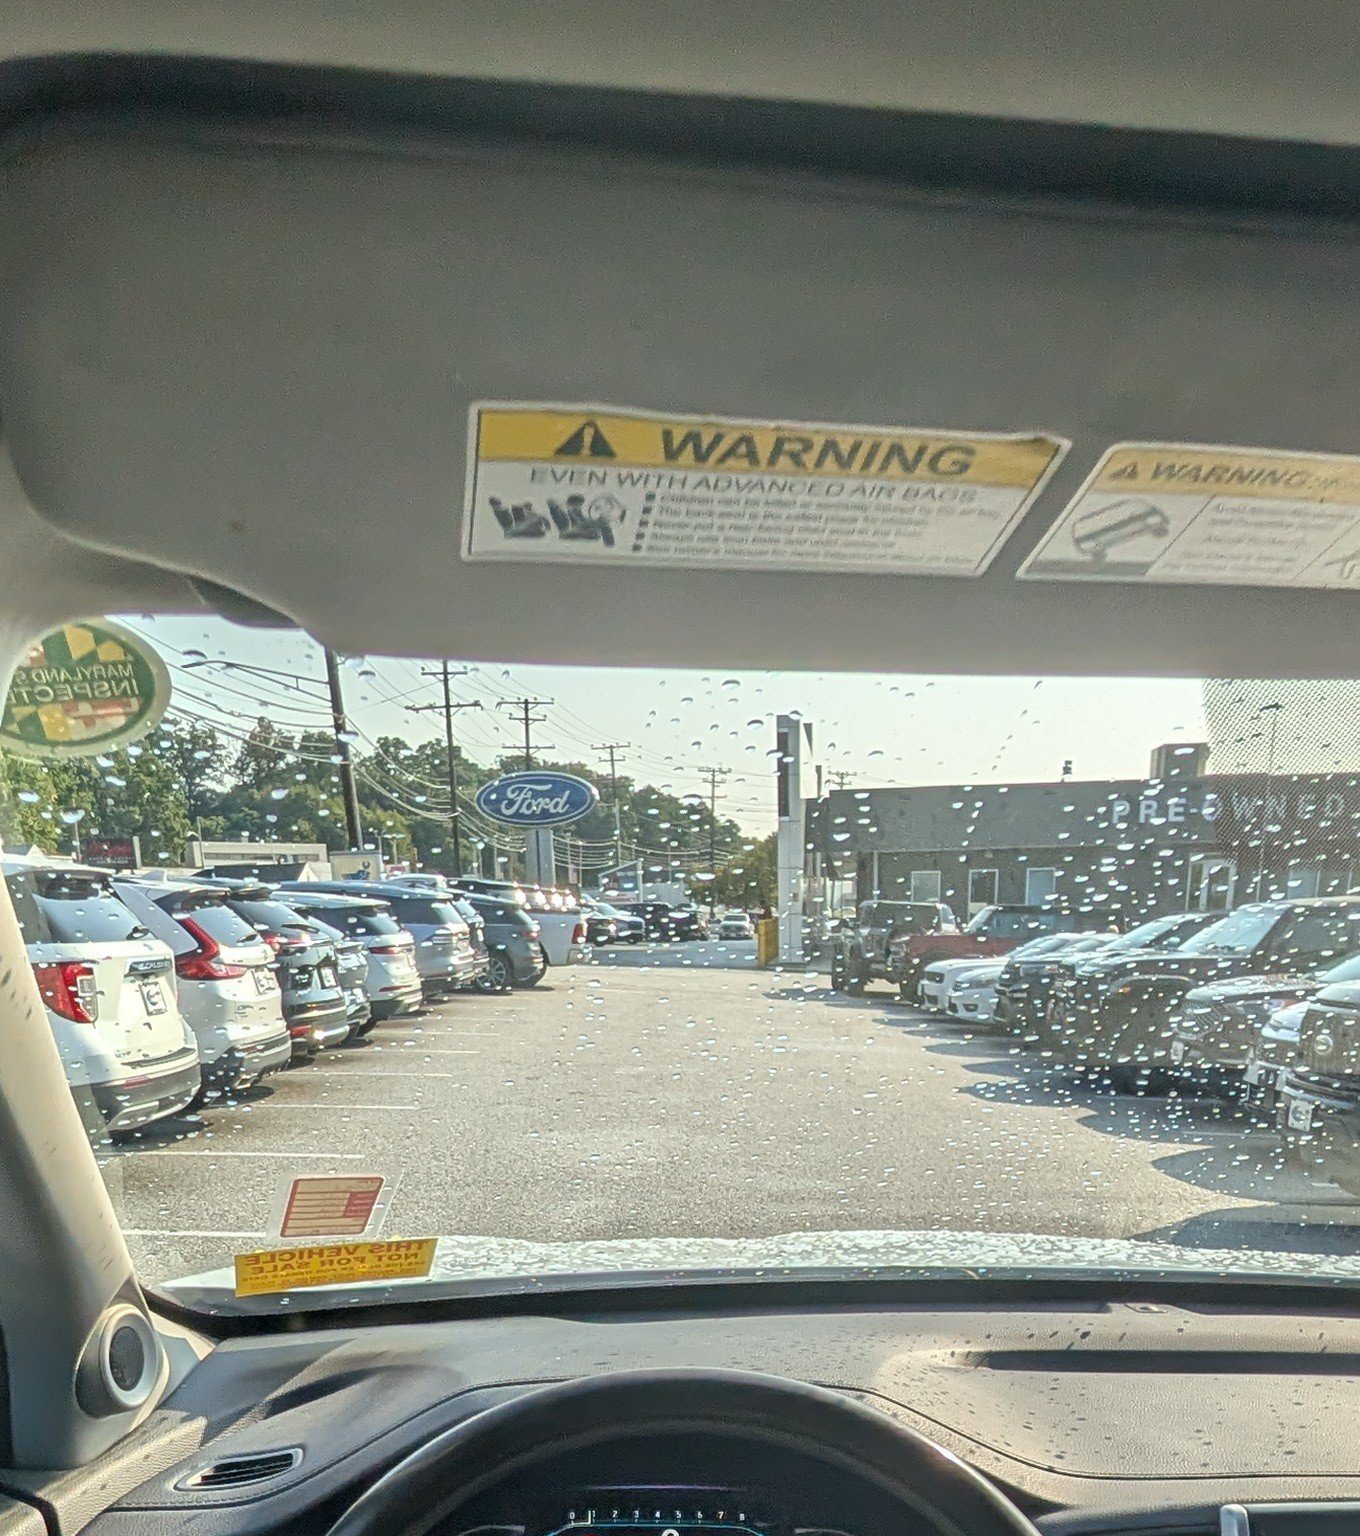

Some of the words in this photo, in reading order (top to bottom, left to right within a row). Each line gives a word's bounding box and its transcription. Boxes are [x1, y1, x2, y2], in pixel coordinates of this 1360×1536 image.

[661, 428, 977, 476] WARNING
[530, 467, 607, 486] EVEN
[616, 471, 688, 490] WITH
[692, 475, 845, 496] ADVANCED
[500, 783, 571, 816] Ford
[1112, 792, 1344, 824] PRE-OWNED
[612, 1510, 618, 1518] 2
[634, 1510, 640, 1518] 3
[655, 1510, 661, 1518] 4
[718, 1511, 724, 1519] 7
